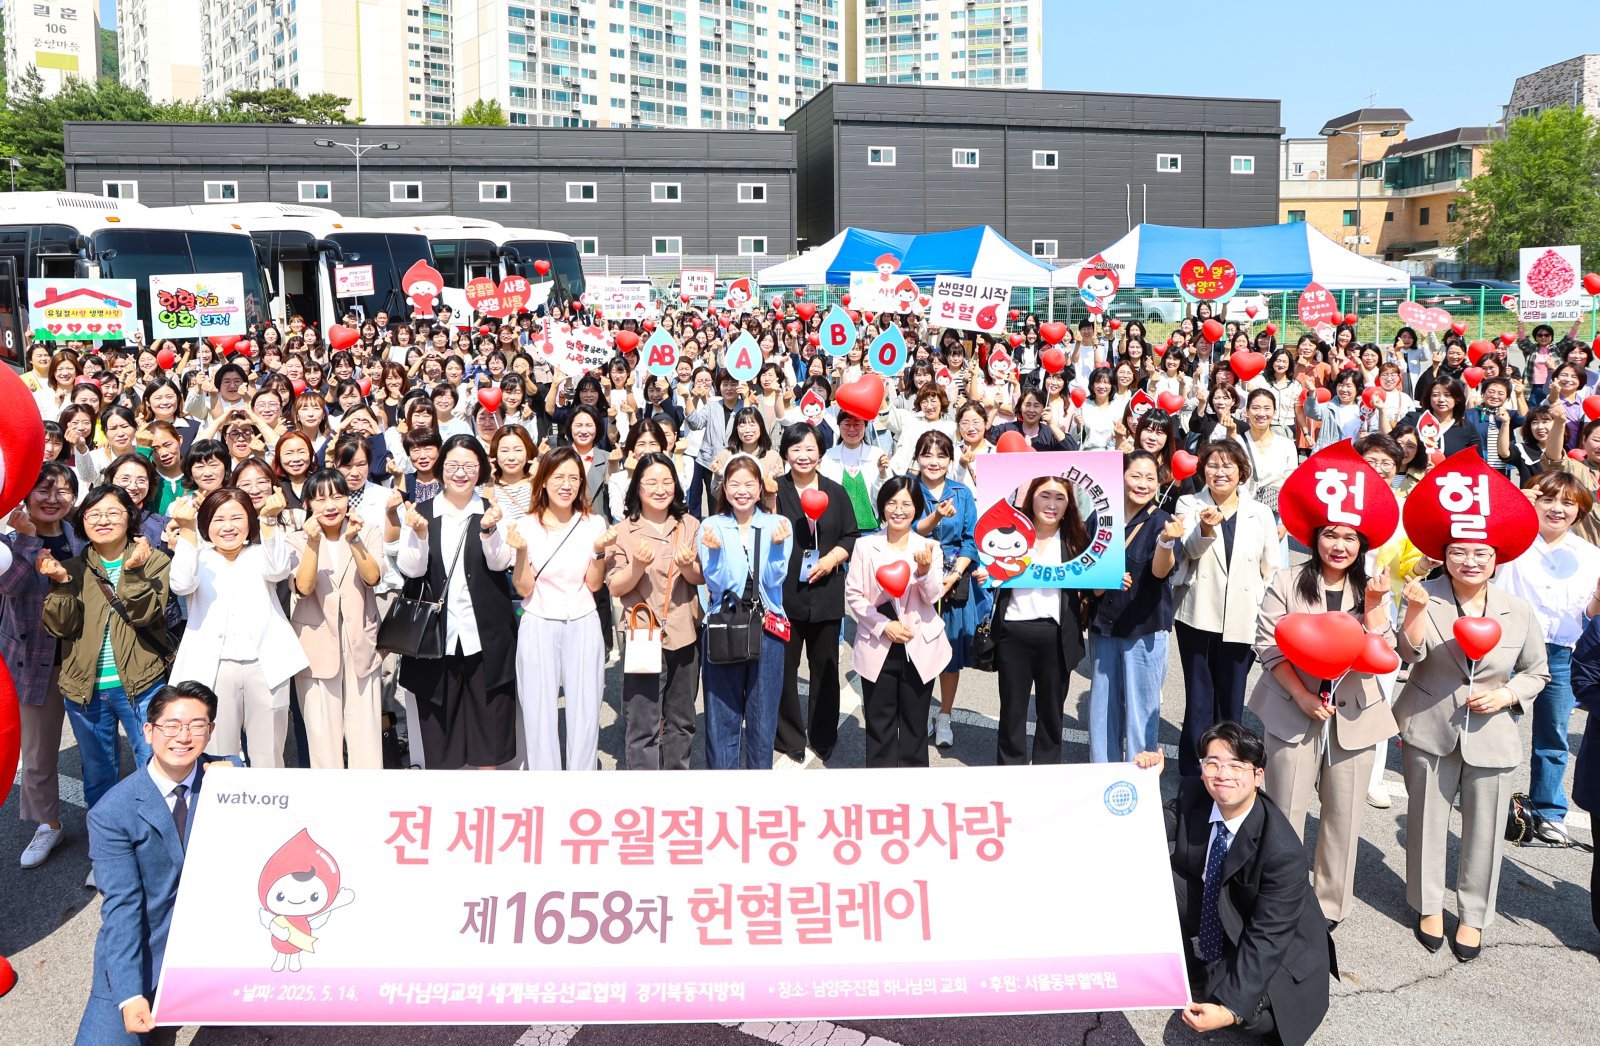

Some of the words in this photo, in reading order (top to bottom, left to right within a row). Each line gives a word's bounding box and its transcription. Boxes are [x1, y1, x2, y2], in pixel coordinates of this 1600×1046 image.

[45, 23, 67, 34] 106
[1193, 266, 1222, 280] 헌혈
[467, 283, 495, 299] 유월절
[503, 279, 526, 293] 사랑
[938, 281, 977, 299] 생명의
[980, 286, 1009, 302] 시작
[1196, 281, 1216, 294] 양주
[157, 288, 219, 312] 헌혈하고
[477, 298, 500, 312] 생명
[501, 295, 523, 309] 사랑
[159, 310, 197, 329] 영화
[200, 313, 230, 326] 보자!
[941, 301, 974, 322] 헌혈
[1523, 311, 1547, 319] 생명을
[5, 330, 13, 349] 8
[830, 323, 847, 345] B
[647, 344, 676, 366] AB
[735, 347, 752, 369] A
[878, 342, 896, 365] O
[1315, 468, 1365, 527] 헌
[1435, 471, 1491, 540] 혈
[1091, 515, 1113, 557] 희망을
[217, 791, 290, 809] watv.org
[384, 805, 432, 865] 전
[446, 805, 544, 865] 세계
[560, 805, 806, 866] 유월절사랑
[817, 801, 1012, 865] 생명사랑
[687, 880, 931, 945] 헌혈릴레이
[243, 985, 274, 1002] 날짜:
[277, 984, 316, 1001] 2025.
[320, 985, 333, 1001] 5.
[338, 985, 358, 1001] 14.
[486, 982, 627, 1004] 세계복음선교협회
[635, 982, 745, 1002] 경기북동지방회
[777, 981, 808, 998] 장소:
[813, 978, 881, 997] 남양주진접
[883, 978, 936, 996] 하나님의
[940, 976, 968, 994] 교회
[990, 975, 1020, 993] 후원:
[1024, 970, 1118, 992] 서울동부혈액원
